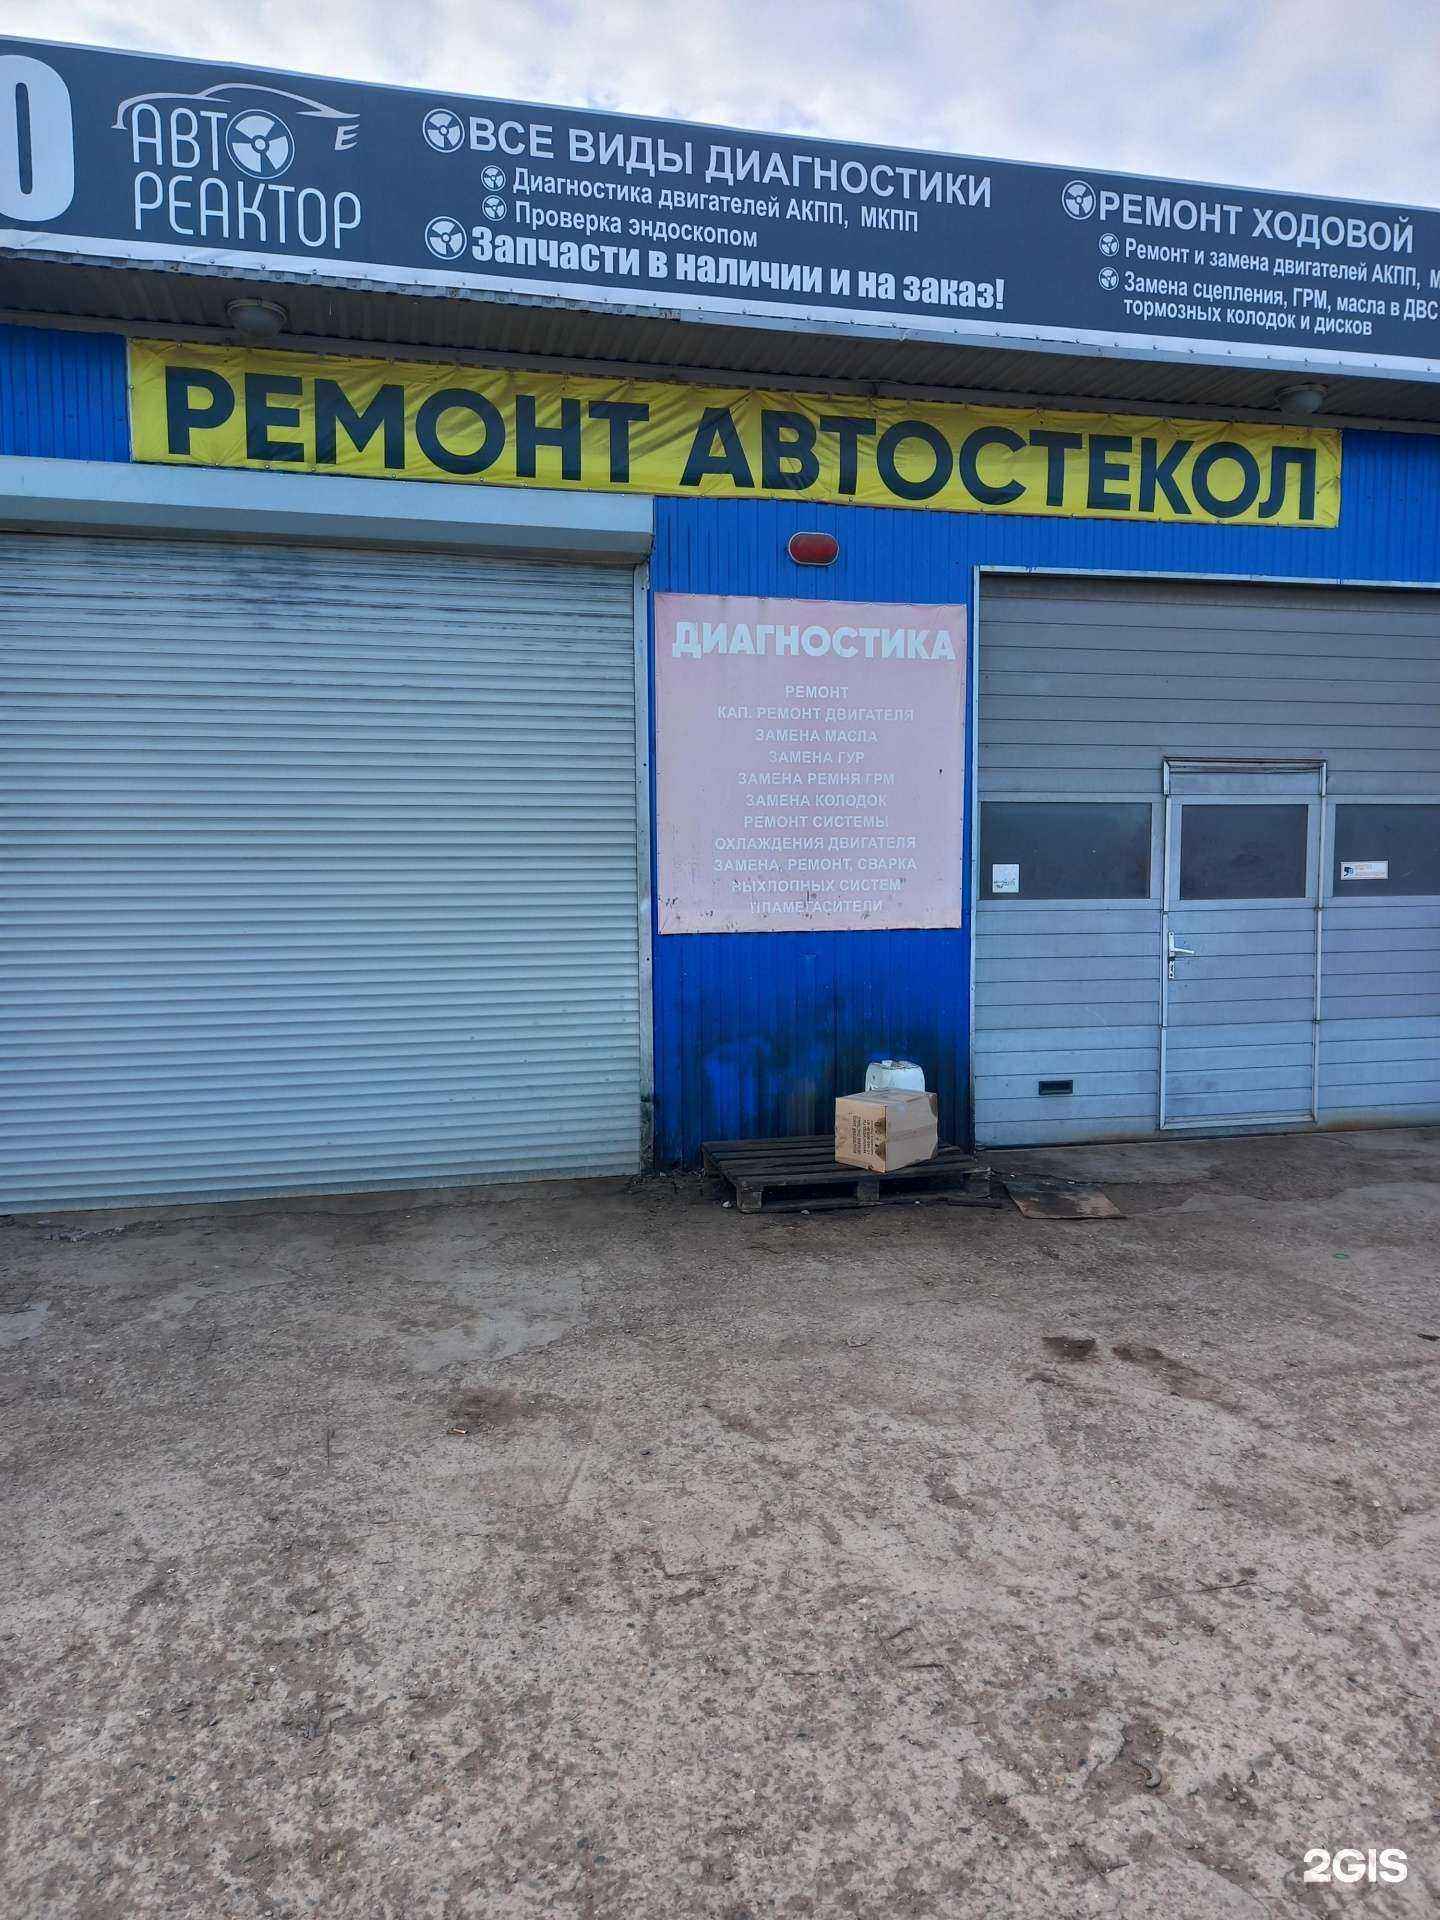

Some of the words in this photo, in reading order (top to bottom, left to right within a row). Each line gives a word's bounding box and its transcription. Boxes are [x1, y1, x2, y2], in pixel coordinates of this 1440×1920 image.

[469, 117, 554, 159] ВСЕ
[569, 129, 693, 178] ВИДЫ
[705, 144, 992, 208] ДИАГНОСТИКИ
[134, 171, 361, 249] РЕАКТОР
[513, 167, 652, 205] Диагностика
[658, 188, 780, 219] двигателей
[786, 198, 849, 229] АКПП,
[861, 206, 918, 232] МКПП
[515, 201, 622, 235] Проверка
[628, 217, 757, 248] эндоскопом
[1099, 190, 1243, 235] РЕМОНТ
[1252, 208, 1414, 253] ХОДОВОЙ
[471, 226, 640, 276] Запчасти
[649, 250, 668, 278] в
[676, 253, 823, 294] наличии
[831, 267, 850, 296] и
[858, 270, 896, 300] на
[903, 275, 1005, 310] заказ!
[1125, 238, 1190, 265] Ремонт
[1194, 250, 1204, 265] и
[1209, 251, 1269, 272] замена
[1273, 258, 1367, 283] двигателей
[1371, 263, 1421, 290] АКПП,
[1124, 271, 1188, 296] Замена
[1193, 281, 1288, 309] сцепления,
[1293, 287, 1332, 313] ГРМ,
[1337, 296, 1386, 315] масла
[1390, 302, 1400, 316] в
[1403, 298, 1439, 322] ДВС
[1124, 299, 1221, 323] тормозных
[1226, 307, 1296, 330] колодок
[1300, 315, 1310, 330] и
[1314, 316, 1372, 336] дисков
[165, 366, 650, 484] РЕМОНТ
[679, 407, 1318, 520] АВТОСТЕКОЛ
[671, 621, 956, 660] ДИАГНОСТИКА
[785, 685, 849, 699] РЕМОНТ
[717, 705, 751, 720] КАП.
[757, 706, 821, 721] РЕМОНТ
[825, 708, 914, 723] ДВИГАТЕЛЯ
[755, 728, 821, 743] ЗАМЕНА
[825, 729, 878, 743] МАСЛА
[769, 750, 833, 765] ЗАМЕНА
[838, 751, 865, 765] ГУР
[738, 772, 802, 786] ЗАМЕНА
[807, 772, 860, 786] РЕМНЯ
[865, 772, 895, 786] ГРМ
[746, 793, 810, 808] ЗАМЕНА
[815, 794, 888, 809] КОЛОДОК
[744, 815, 807, 829] РЕМОНТ
[812, 815, 889, 829] СИСТЕМЫ
[714, 836, 824, 852] ОХЛАЖДЕНИЯ
[828, 836, 916, 852] ДВИГАТЕЛЯ
[787, 857, 853, 873] РЕМОНТ,
[858, 857, 917, 871] СВАРКА
[839, 878, 902, 893] СИСТЕМ
